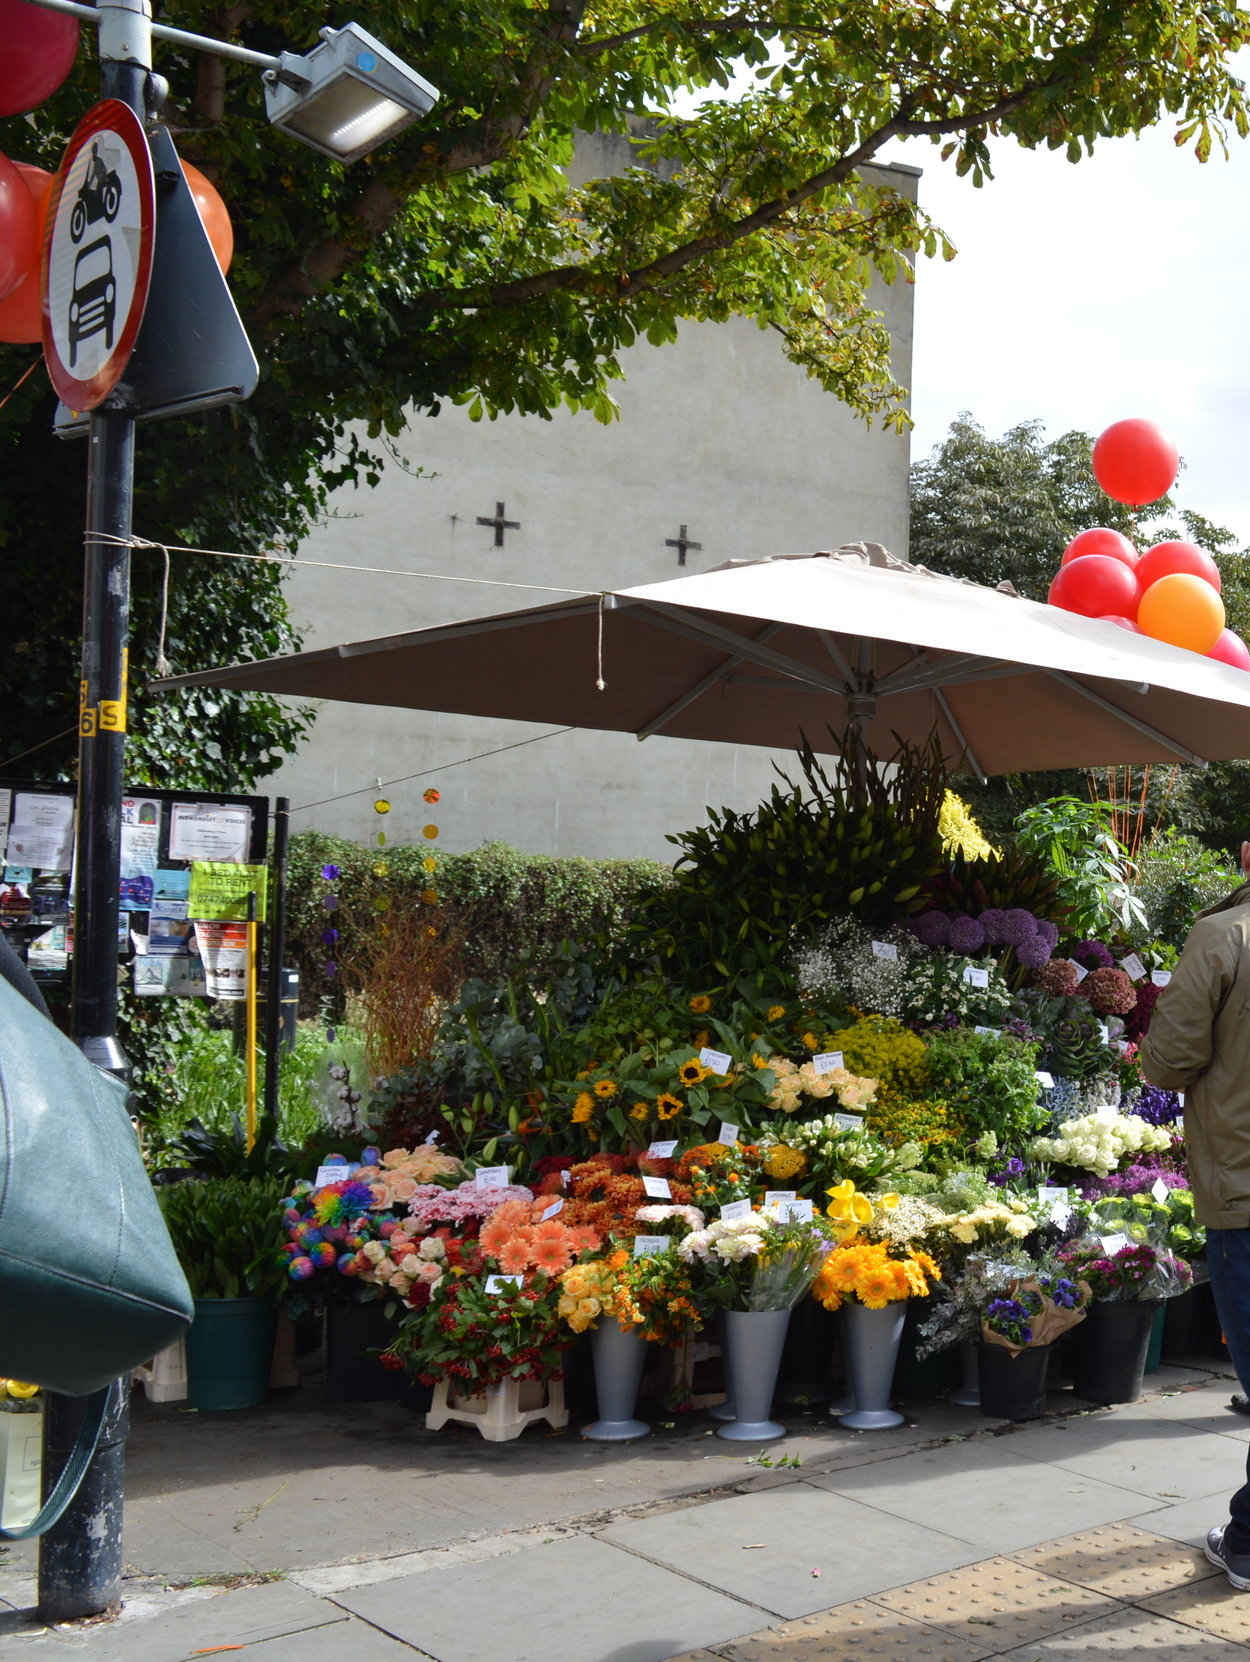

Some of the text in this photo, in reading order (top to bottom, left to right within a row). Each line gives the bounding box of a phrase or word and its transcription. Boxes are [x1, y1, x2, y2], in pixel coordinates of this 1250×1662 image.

[81, 711, 93, 734] 6
[102, 704, 118, 727] S
[210, 868, 231, 877] BED
[209, 878, 252, 888] TO RENT
